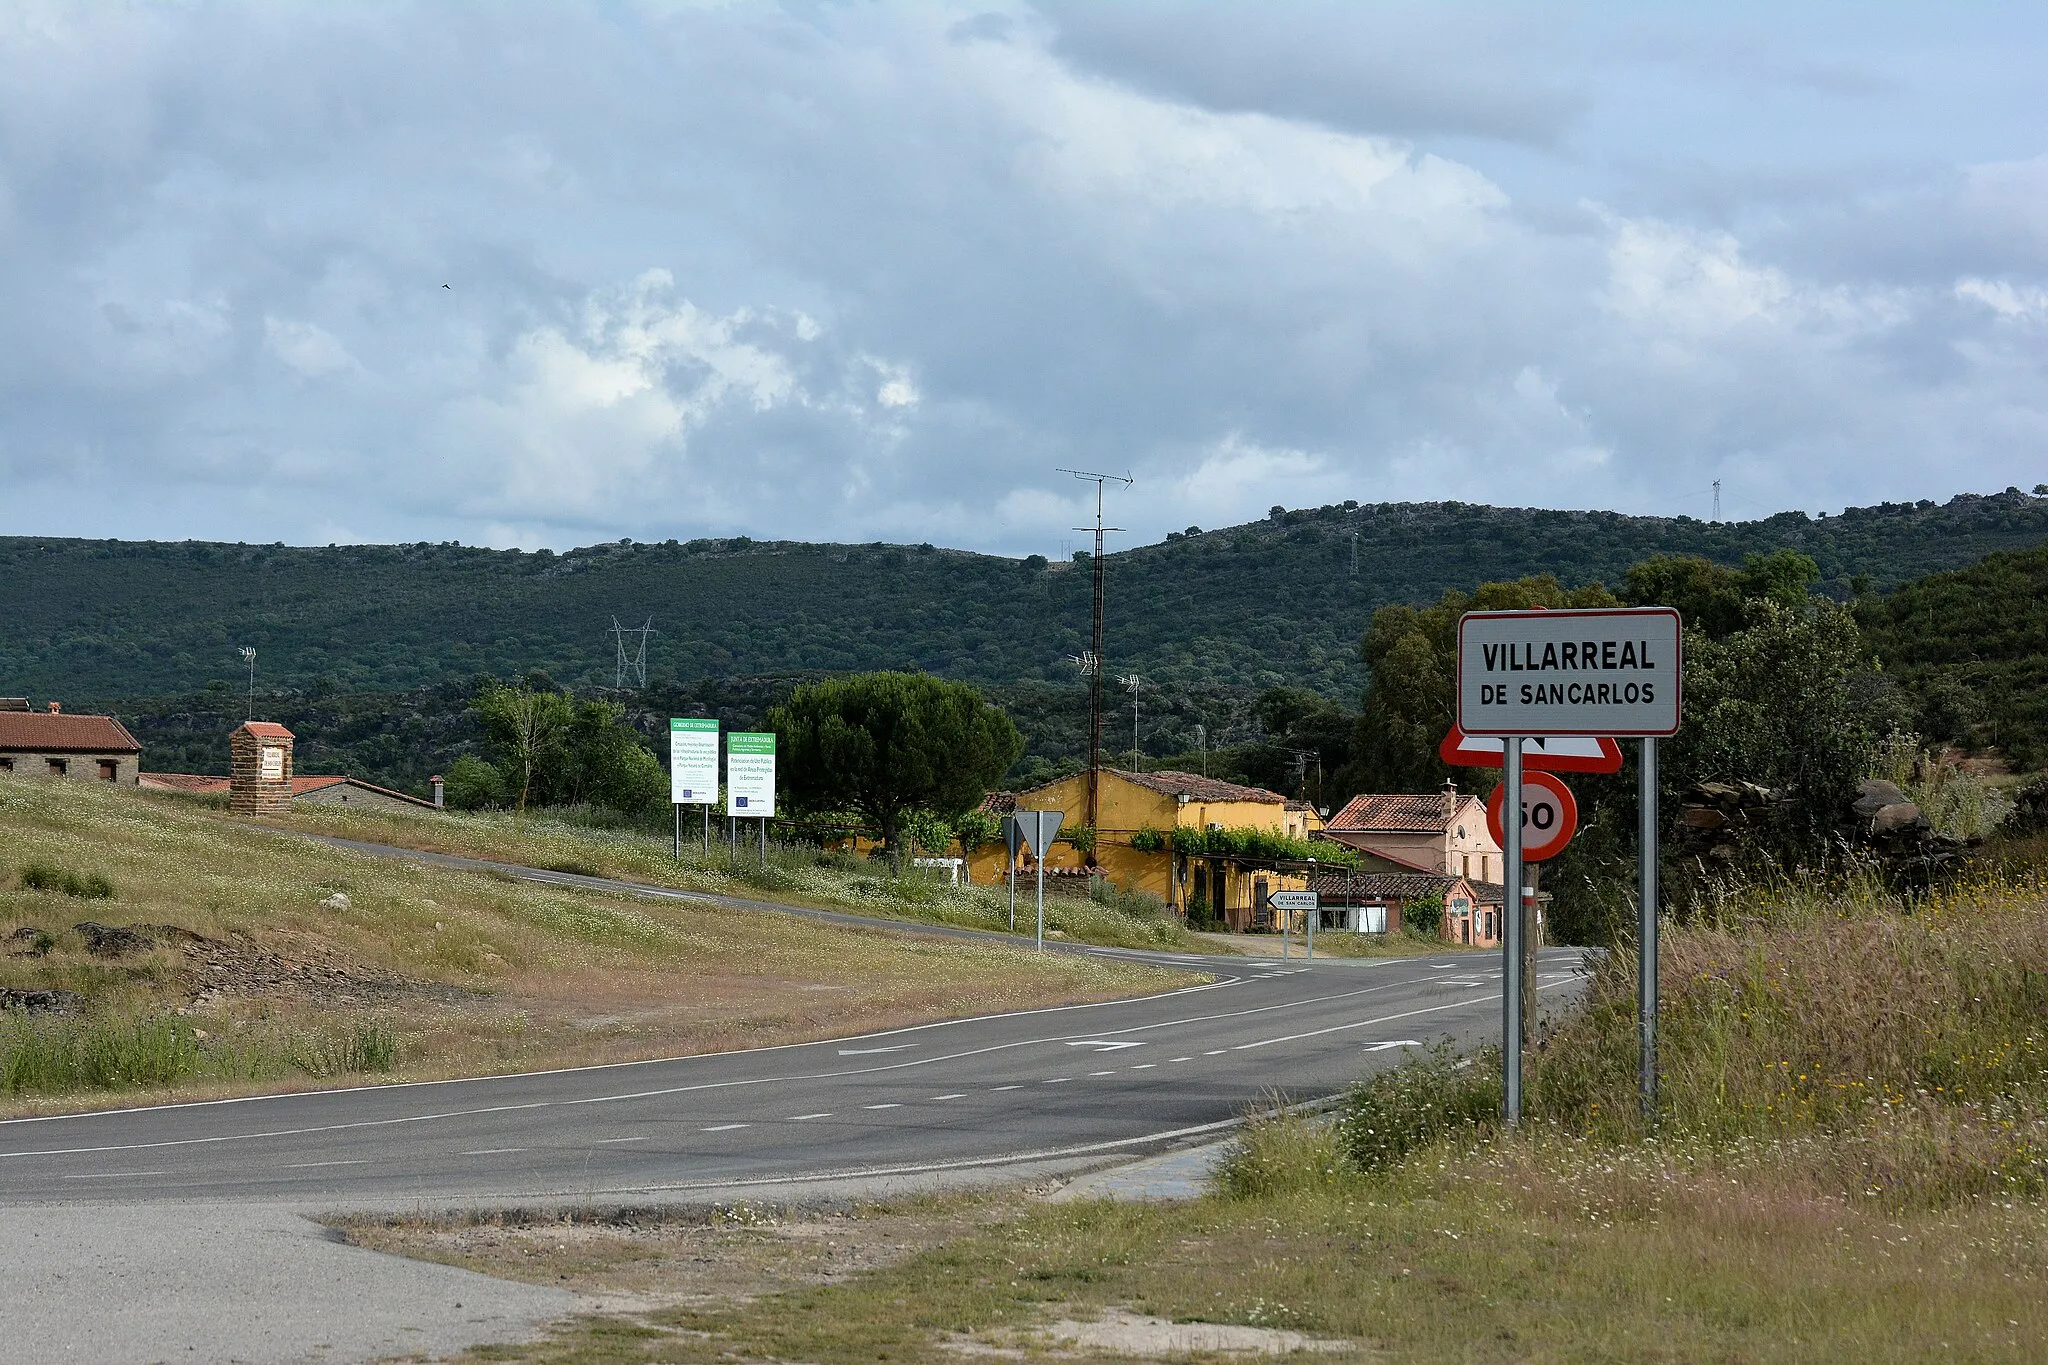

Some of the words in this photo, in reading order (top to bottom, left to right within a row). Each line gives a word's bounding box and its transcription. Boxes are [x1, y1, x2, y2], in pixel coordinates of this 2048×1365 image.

[1482, 640, 1655, 672] VILLARREAL
[1481, 684, 1507, 705] DE
[748, 736, 774, 744] EXTREMADURA
